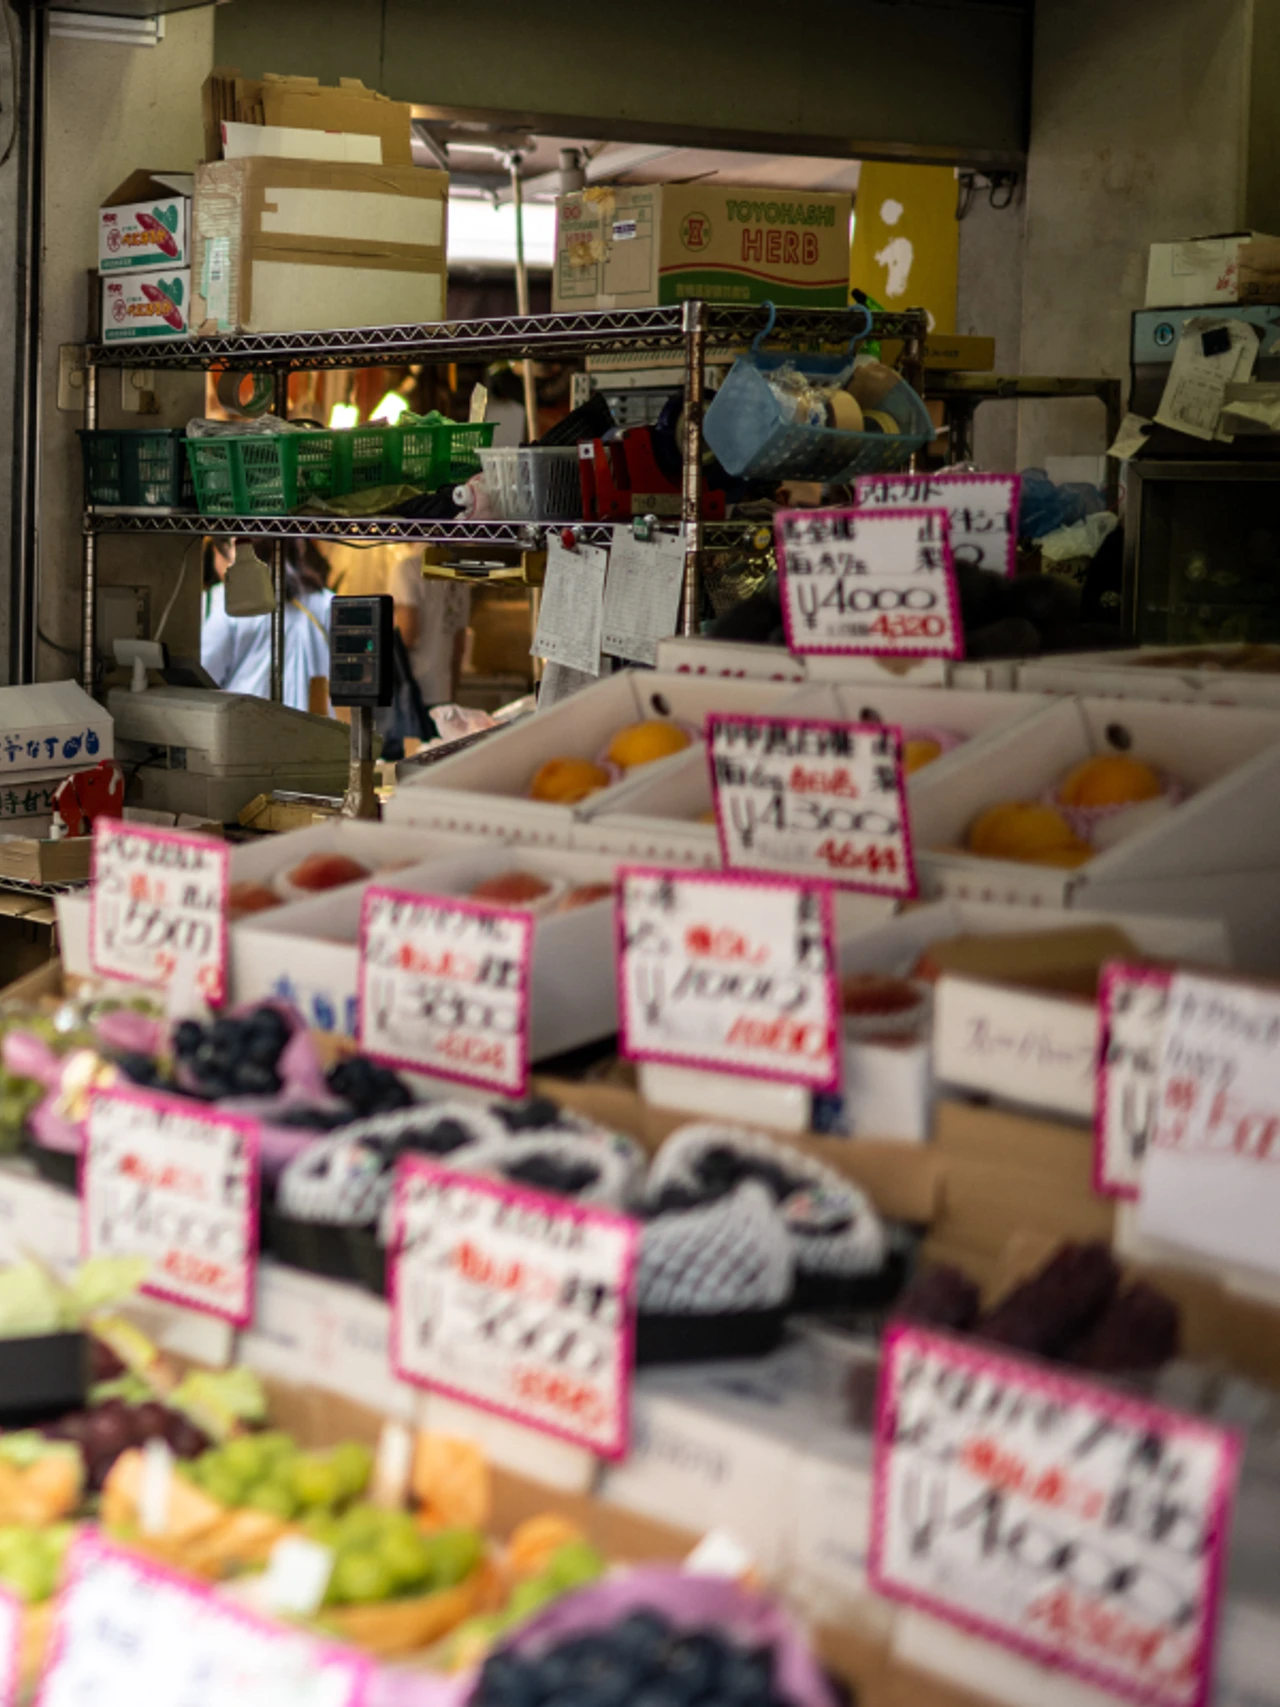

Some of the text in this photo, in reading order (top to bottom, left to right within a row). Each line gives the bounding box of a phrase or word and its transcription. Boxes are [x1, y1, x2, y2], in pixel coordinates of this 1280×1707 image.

[725, 199, 835, 227] TOYOHASHI
[741, 228, 819, 266] HERB
[870, 614, 946, 639] 4320
